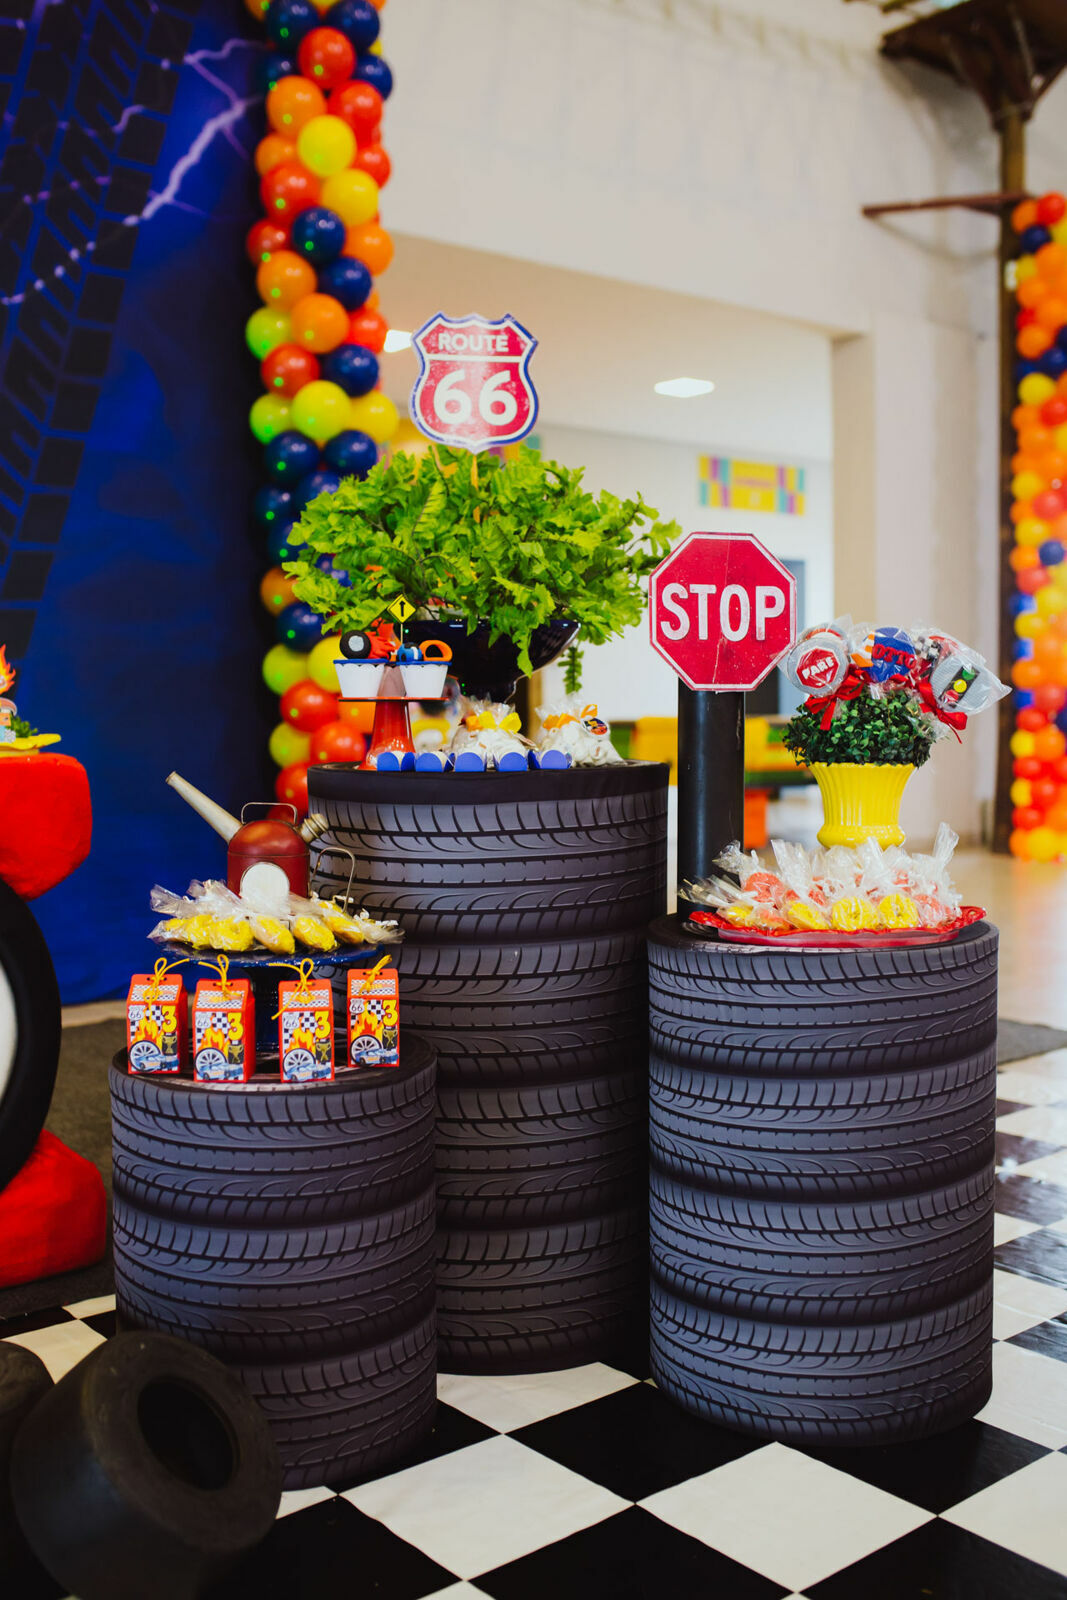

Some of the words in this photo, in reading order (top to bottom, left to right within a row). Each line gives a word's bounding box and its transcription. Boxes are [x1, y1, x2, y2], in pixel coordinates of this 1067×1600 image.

[438, 333, 509, 352] ROUTE
[433, 369, 518, 426] 66
[660, 582, 785, 642] STOP
[801, 656, 834, 680] PARE
[161, 1005, 177, 1033] 3
[227, 1012, 244, 1040] 3
[314, 1010, 331, 1039] 3
[382, 999, 398, 1026] 3
